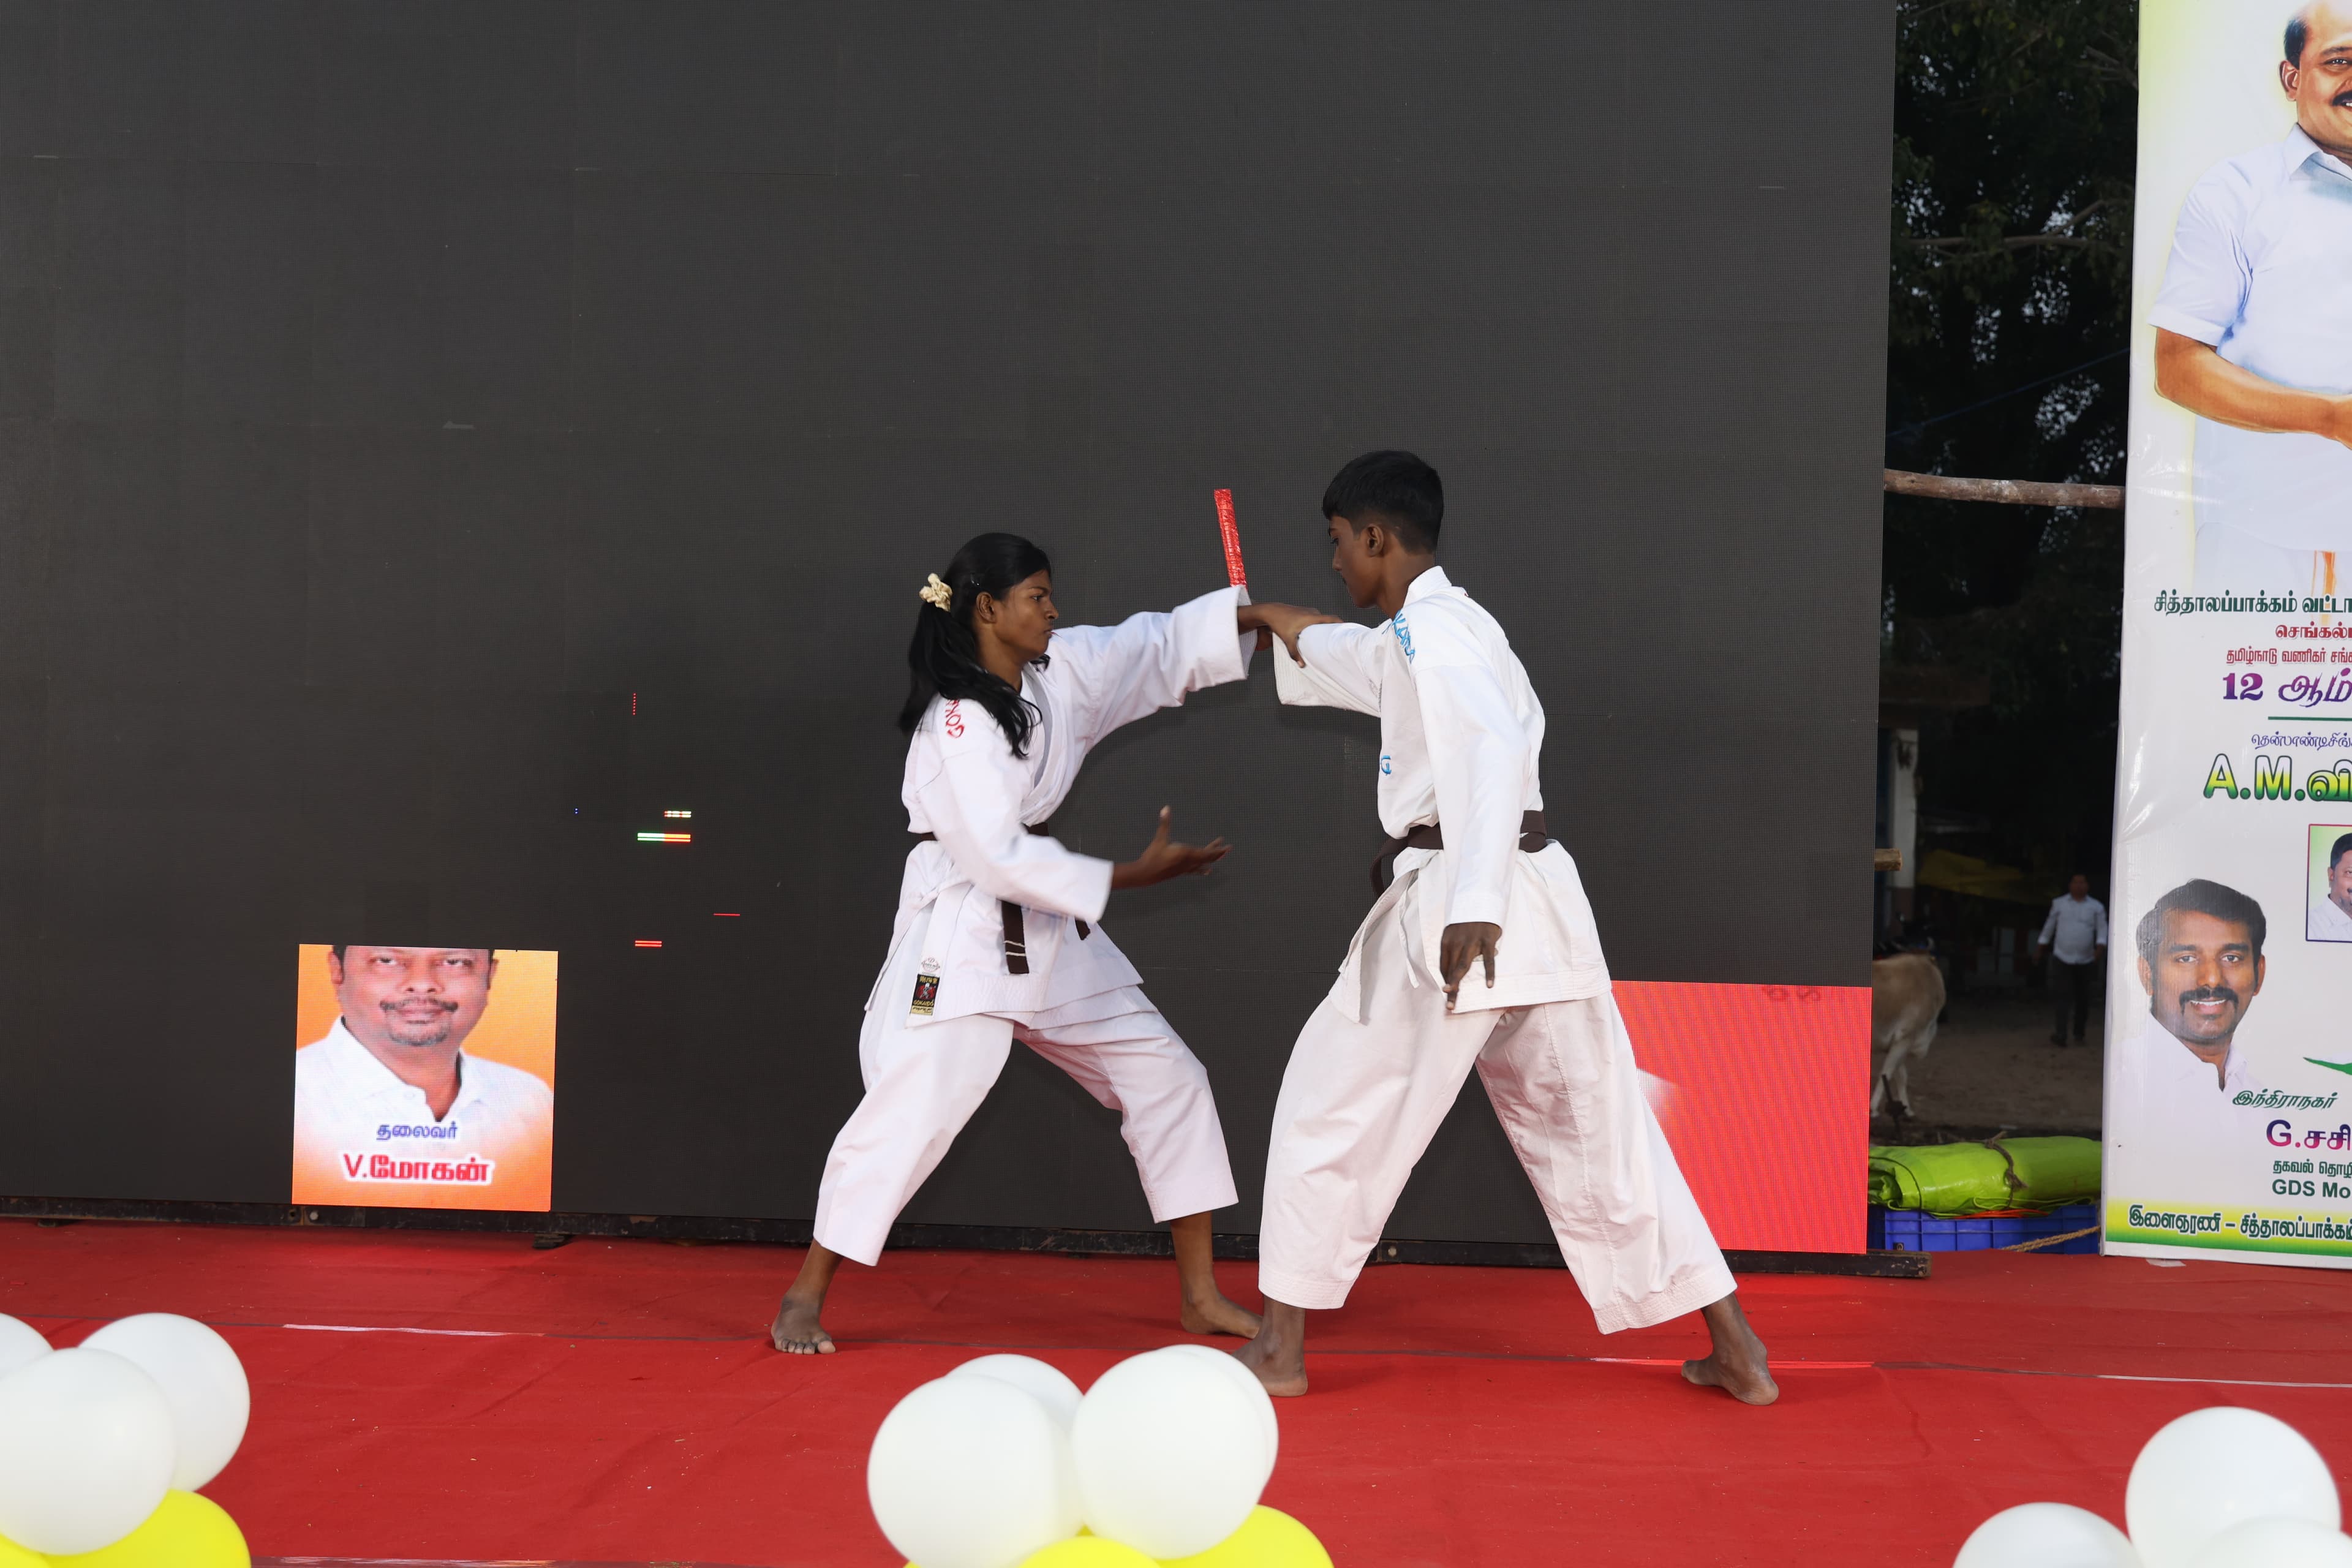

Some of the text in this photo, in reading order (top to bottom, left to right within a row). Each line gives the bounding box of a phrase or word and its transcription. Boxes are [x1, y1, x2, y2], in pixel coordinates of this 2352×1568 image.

[2154, 589, 2297, 617] சித்தாலப்பாக்கம்
[2226, 646, 2278, 665] தமிழ்நாடு
[2282, 647, 2326, 663] வணிகர்
[2222, 673, 2264, 701] 12
[2251, 731, 2352, 752] தென்பாண்டிசிங்
[2232, 1088, 2339, 1110] இந்திராநகர்
[376, 1121, 458, 1141] தலைவர்
[343, 1153, 489, 1182] V.மோகன்
[2273, 1158, 2314, 1174] தகவல்
[2272, 1178, 2351, 1199] GDS Mo
